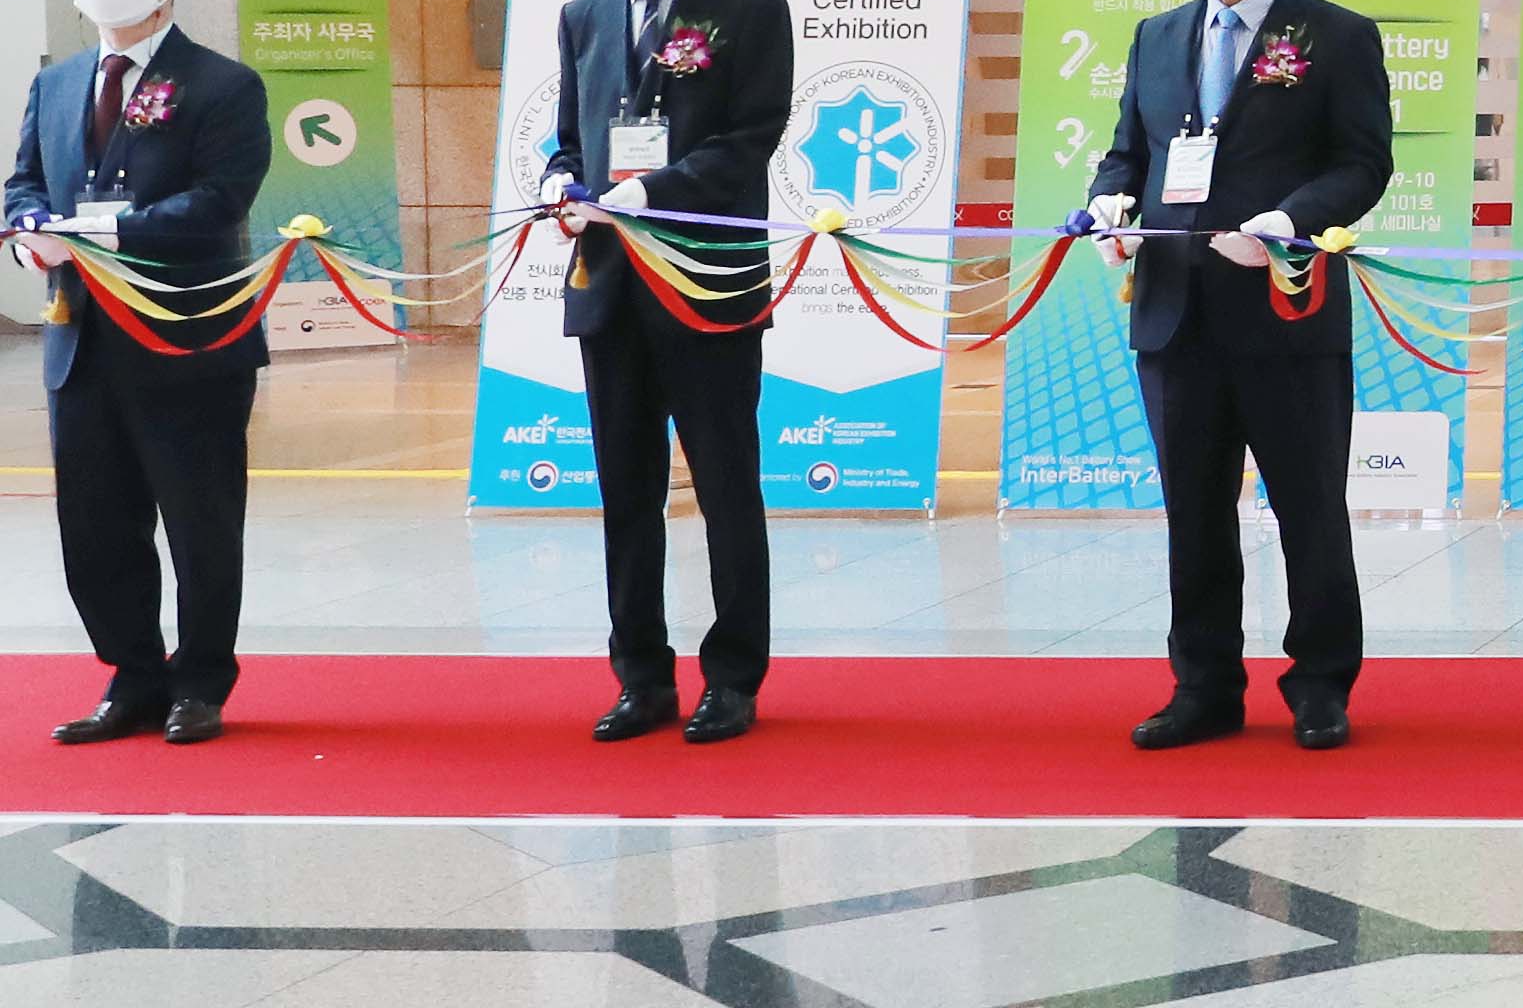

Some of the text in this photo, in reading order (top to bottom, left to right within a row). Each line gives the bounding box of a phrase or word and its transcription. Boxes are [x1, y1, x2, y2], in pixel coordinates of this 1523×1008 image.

[253, 22, 376, 42] 주최자 사무국
[803, 17, 929, 41] Exhibition
[335, 48, 375, 60] Office
[1382, 32, 1450, 60] ttery
[823, 68, 875, 87] KOREAN
[876, 70, 929, 117] EXHIBITION
[1390, 193, 1435, 210] 101호
[1381, 214, 1441, 232] 세미나실
[527, 263, 565, 278] 전시회
[501, 287, 528, 301] 인증
[837, 302, 855, 314] the
[503, 420, 552, 444] AKEI
[778, 421, 829, 445] AKEI
[1021, 466, 1140, 488] InterBattery
